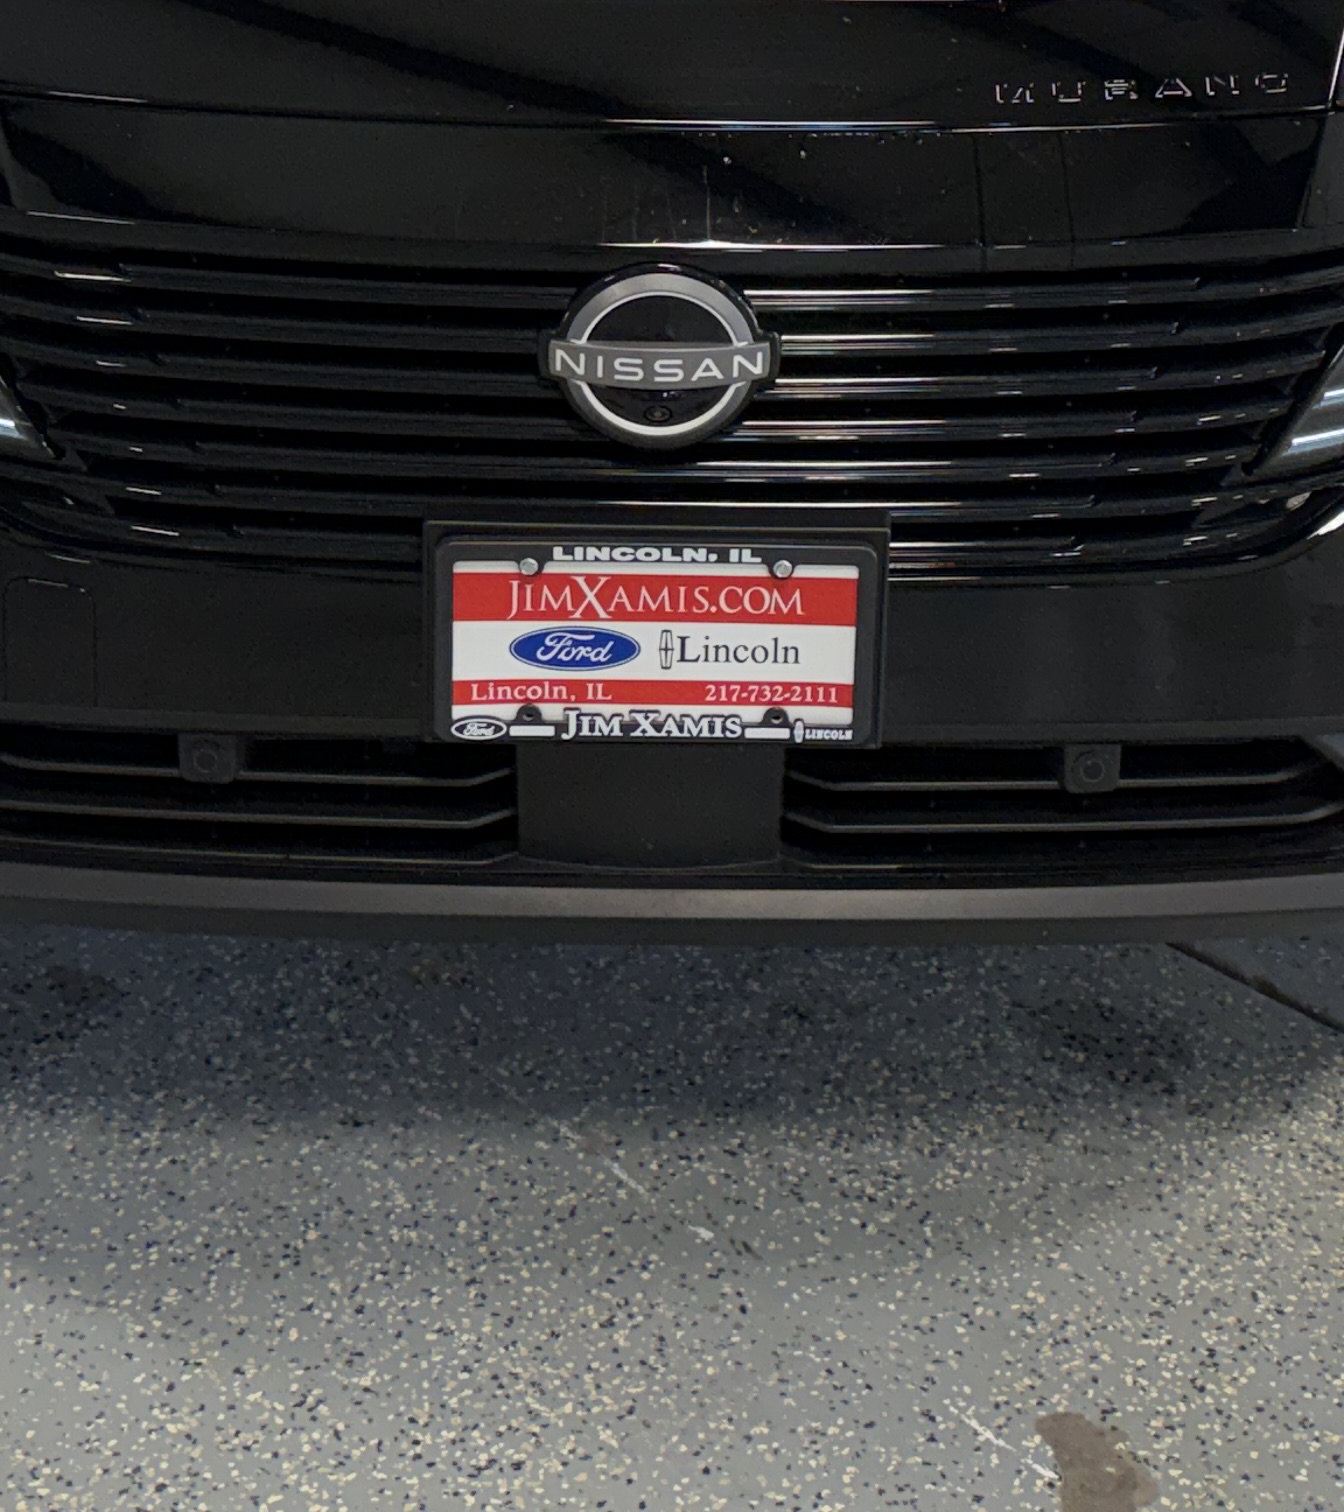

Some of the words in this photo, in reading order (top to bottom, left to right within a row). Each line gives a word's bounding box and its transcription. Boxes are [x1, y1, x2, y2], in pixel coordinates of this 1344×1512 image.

[995, 73, 1288, 104] MURANO
[556, 349, 763, 382] NISSAN
[729, 548, 762, 563] IL
[507, 575, 805, 621] JIMXAMIS.COM
[536, 633, 613, 663] Ford
[676, 635, 800, 665] Lincoln
[471, 682, 576, 701] Lincoln,
[586, 683, 612, 701] IL
[705, 685, 838, 703] 217-732-2111
[561, 708, 623, 740] JIM
[630, 711, 742, 740] XAMIS
[805, 728, 853, 740] LINCOLN
